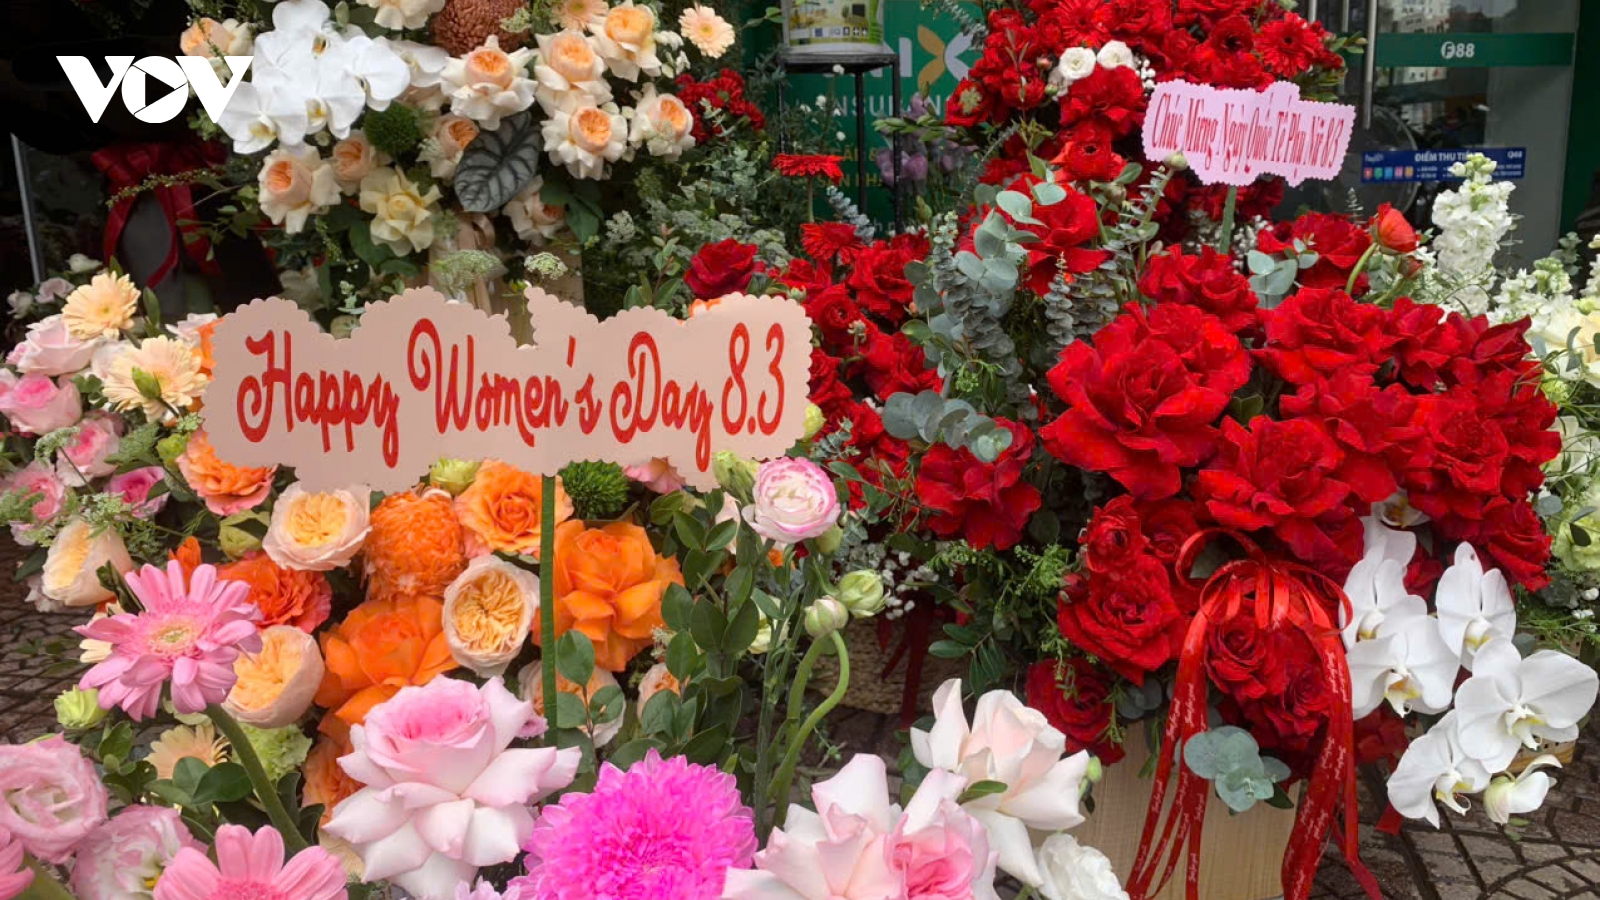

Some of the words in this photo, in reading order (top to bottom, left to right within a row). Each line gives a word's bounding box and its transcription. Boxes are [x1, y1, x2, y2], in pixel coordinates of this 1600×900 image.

[1441, 41, 1475, 59] F88
[1152, 93, 1183, 148] Chúc
[236, 329, 400, 469] Happy
[407, 318, 603, 448] Women's
[609, 331, 714, 473] Day
[721, 322, 785, 436] 8.3
